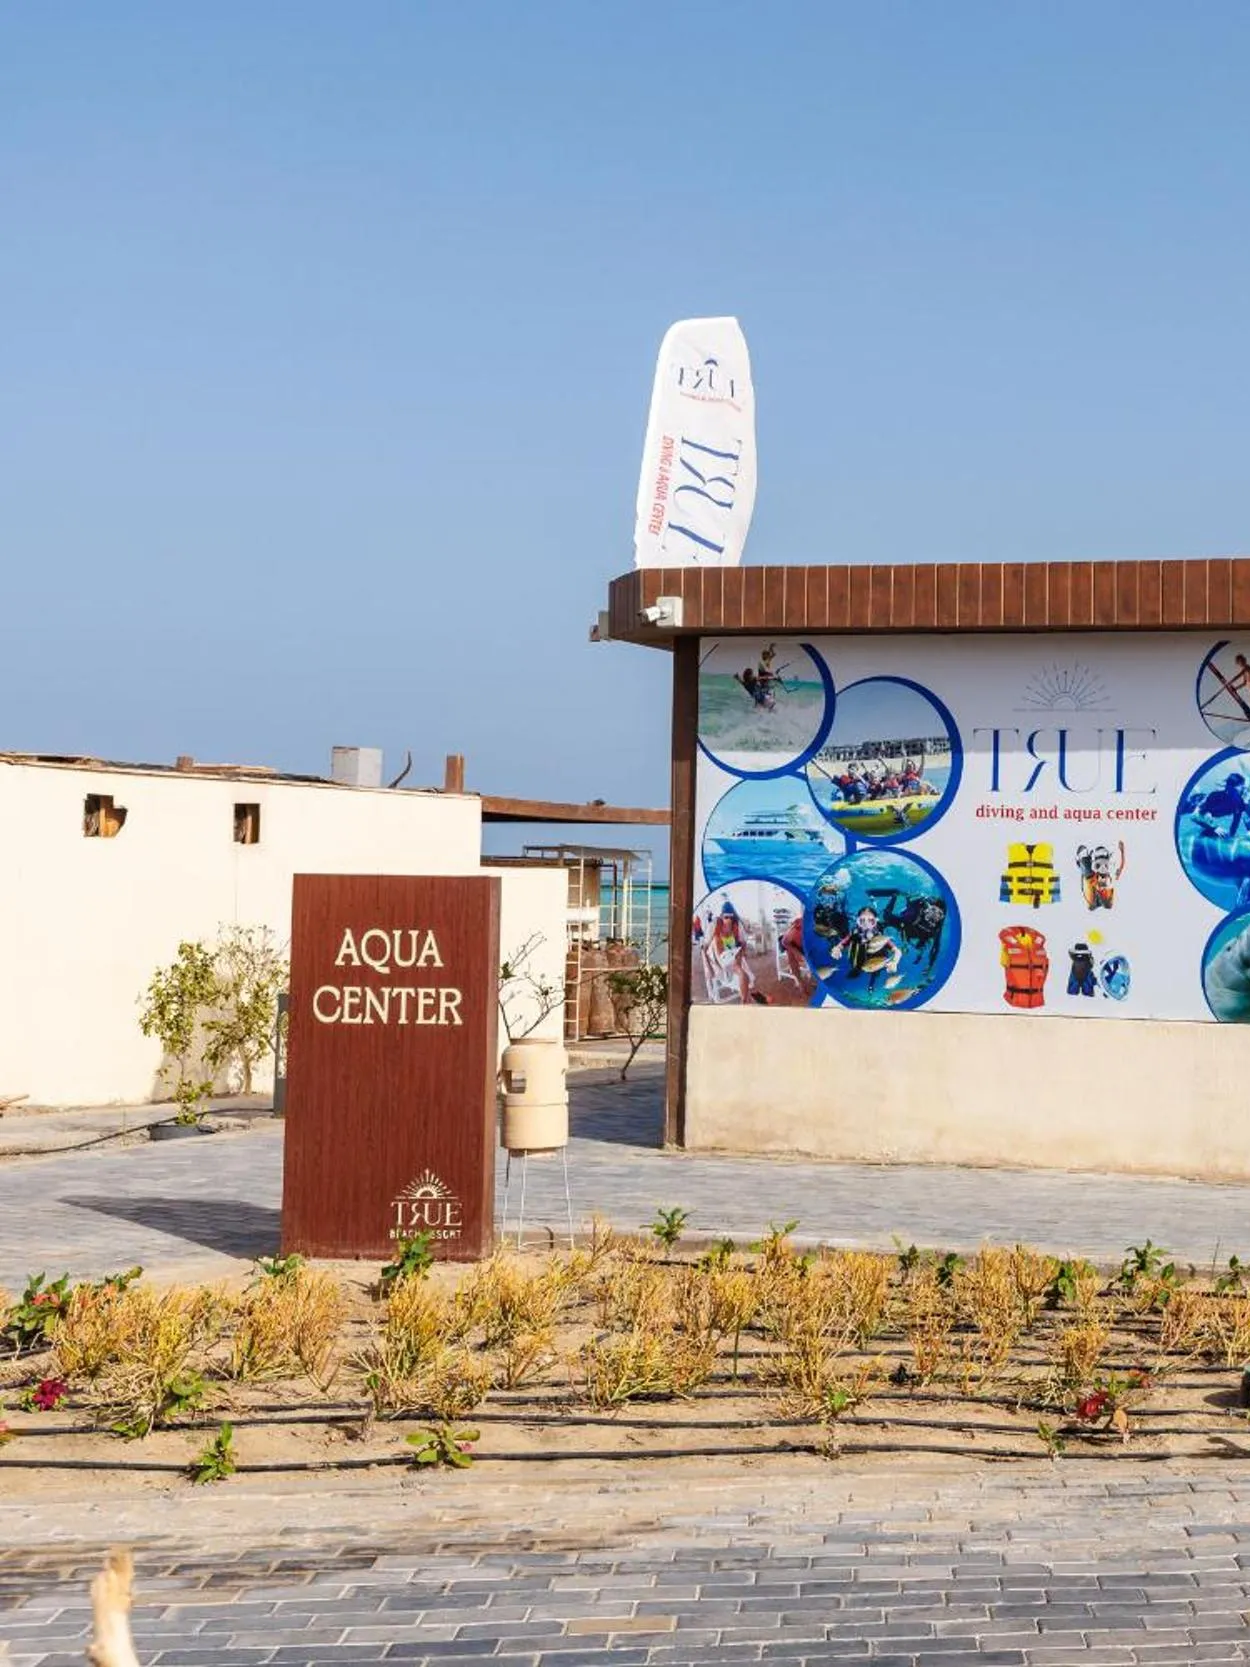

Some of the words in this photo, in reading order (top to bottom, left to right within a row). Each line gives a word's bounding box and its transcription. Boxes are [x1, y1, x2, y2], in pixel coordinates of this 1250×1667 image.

[655, 472, 671, 500] AQUA
[973, 728, 1157, 794] TRUE
[975, 804, 1025, 822] diving
[1029, 805, 1059, 820] and
[1064, 807, 1102, 823] aqua
[1107, 808, 1158, 822] center
[334, 928, 444, 974] AQUA
[312, 985, 463, 1026] CENTER
[390, 1201, 463, 1226] TRUE
[427, 1229, 462, 1240] ESORT
